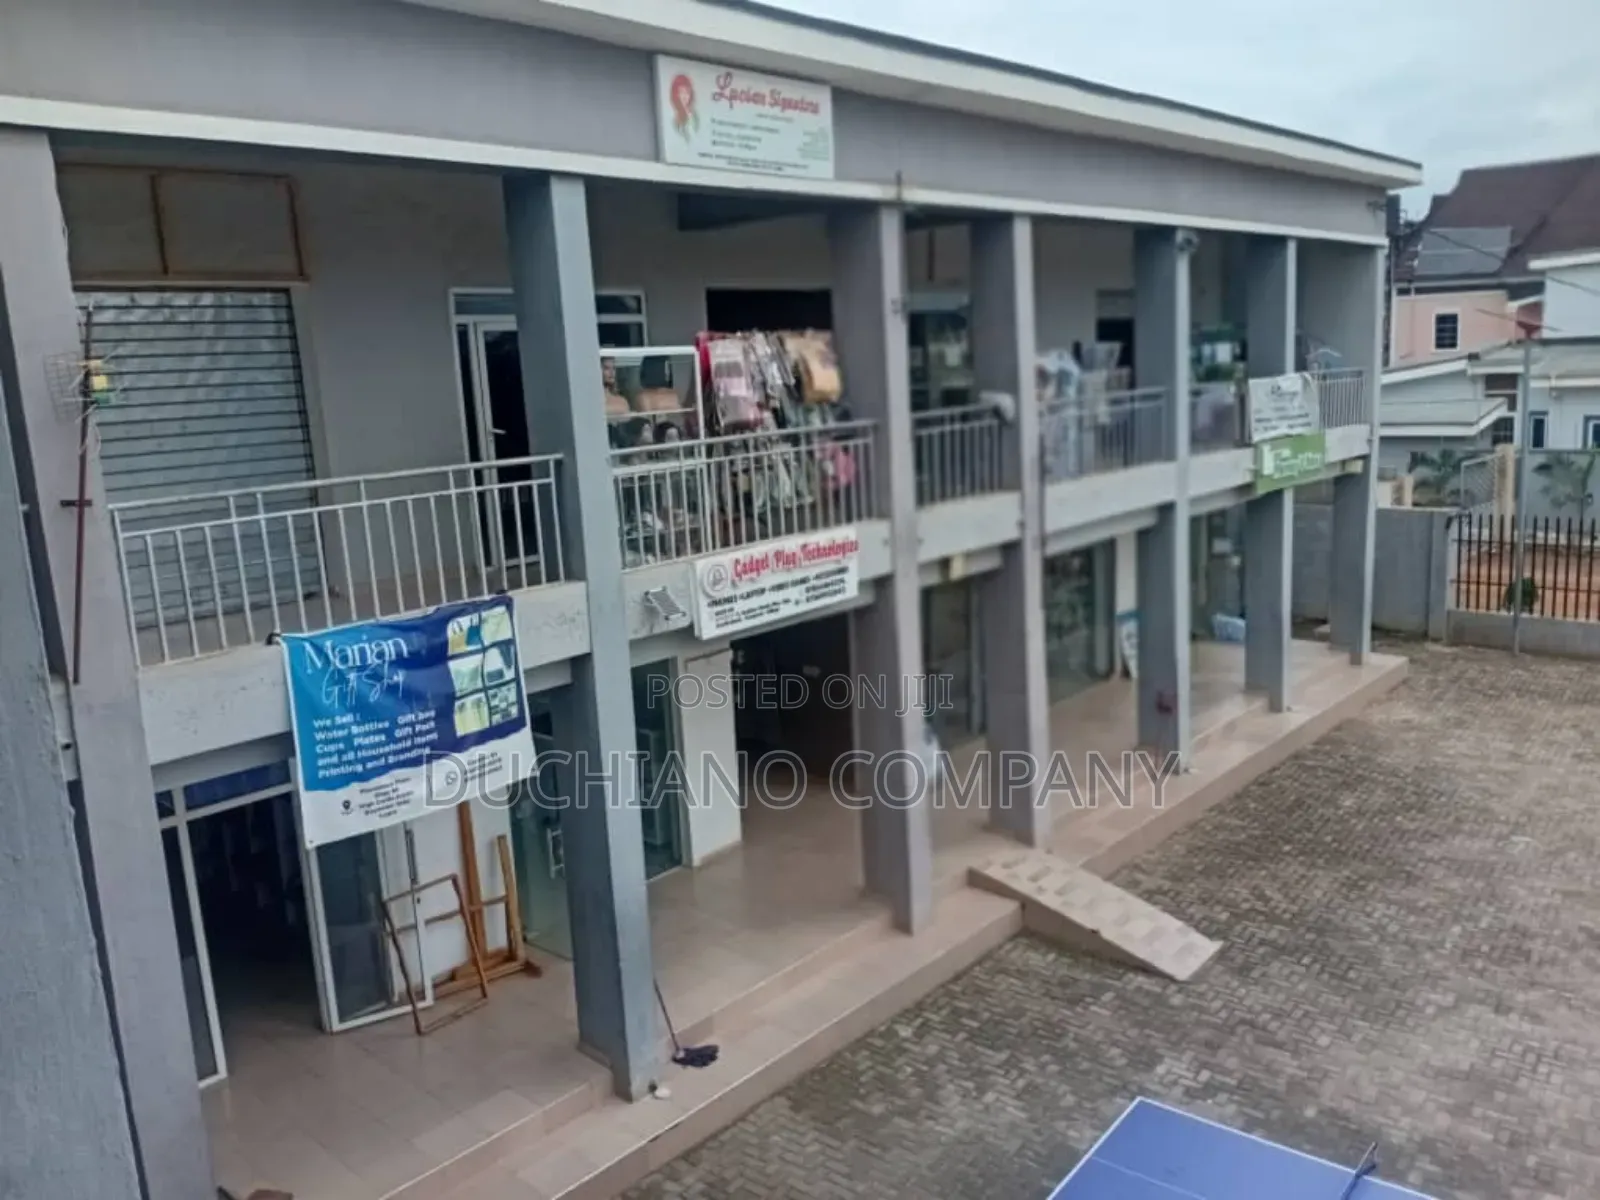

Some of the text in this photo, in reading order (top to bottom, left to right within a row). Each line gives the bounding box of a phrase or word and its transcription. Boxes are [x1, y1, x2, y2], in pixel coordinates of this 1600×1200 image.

[733, 537, 859, 579] Gadget Plus Technologies
[303, 635, 409, 673] Marian
[313, 718, 331, 729] We
[313, 728, 348, 741] Water
[351, 720, 390, 735] Bottles
[397, 713, 416, 725] Gift
[316, 742, 345, 754] Cups
[353, 733, 386, 747] Plates
[394, 726, 413, 739] Gift
[318, 753, 339, 767] and
[357, 739, 412, 759] Household
[318, 745, 431, 779] Printing and Branding
